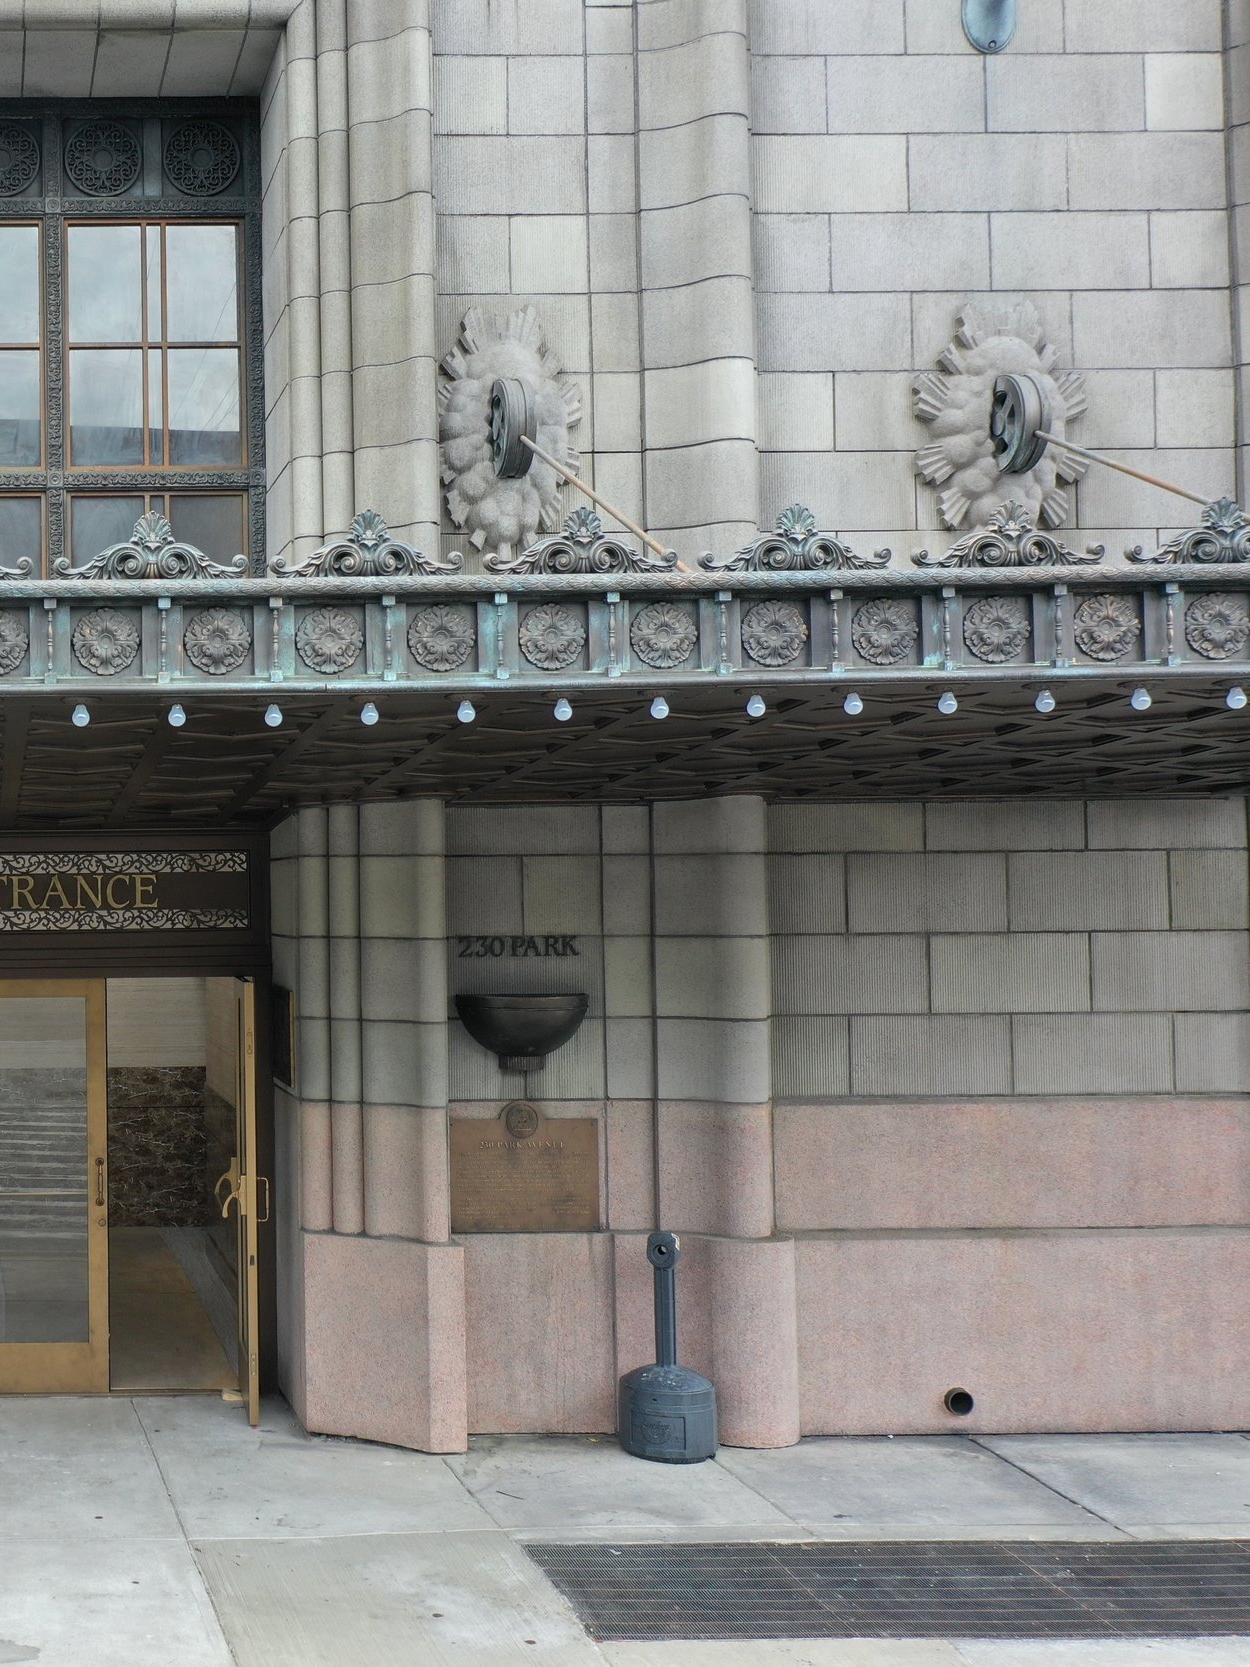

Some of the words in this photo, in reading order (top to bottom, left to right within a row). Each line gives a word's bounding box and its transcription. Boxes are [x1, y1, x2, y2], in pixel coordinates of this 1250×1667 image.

[457, 936, 505, 958] 230
[510, 935, 580, 957] PARK
[497, 1140, 523, 1149] PARK
